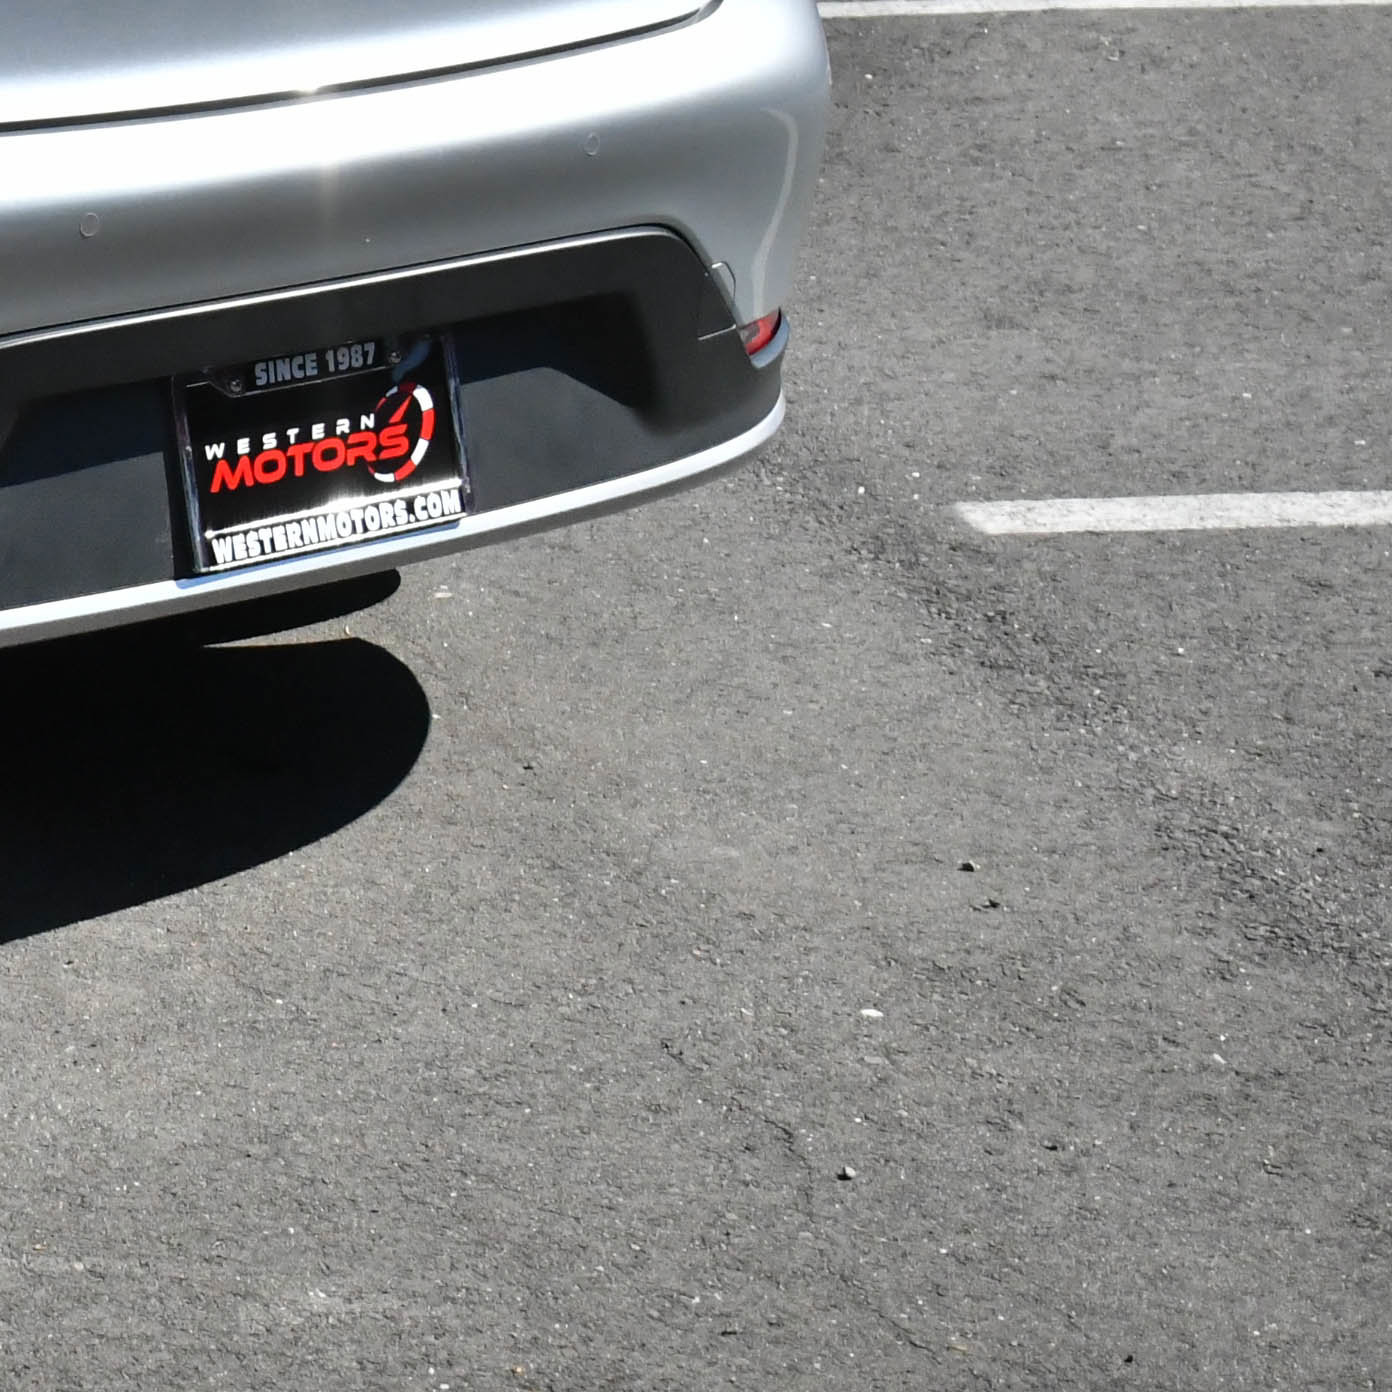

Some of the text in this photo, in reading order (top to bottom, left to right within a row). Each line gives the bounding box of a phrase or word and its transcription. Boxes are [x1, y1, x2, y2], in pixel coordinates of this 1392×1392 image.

[255, 342, 375, 386] SINCE 1987
[205, 413, 375, 460] WESTERN
[210, 423, 409, 494] MOTORS
[212, 488, 461, 565] WESTERNMOTORS.COM
